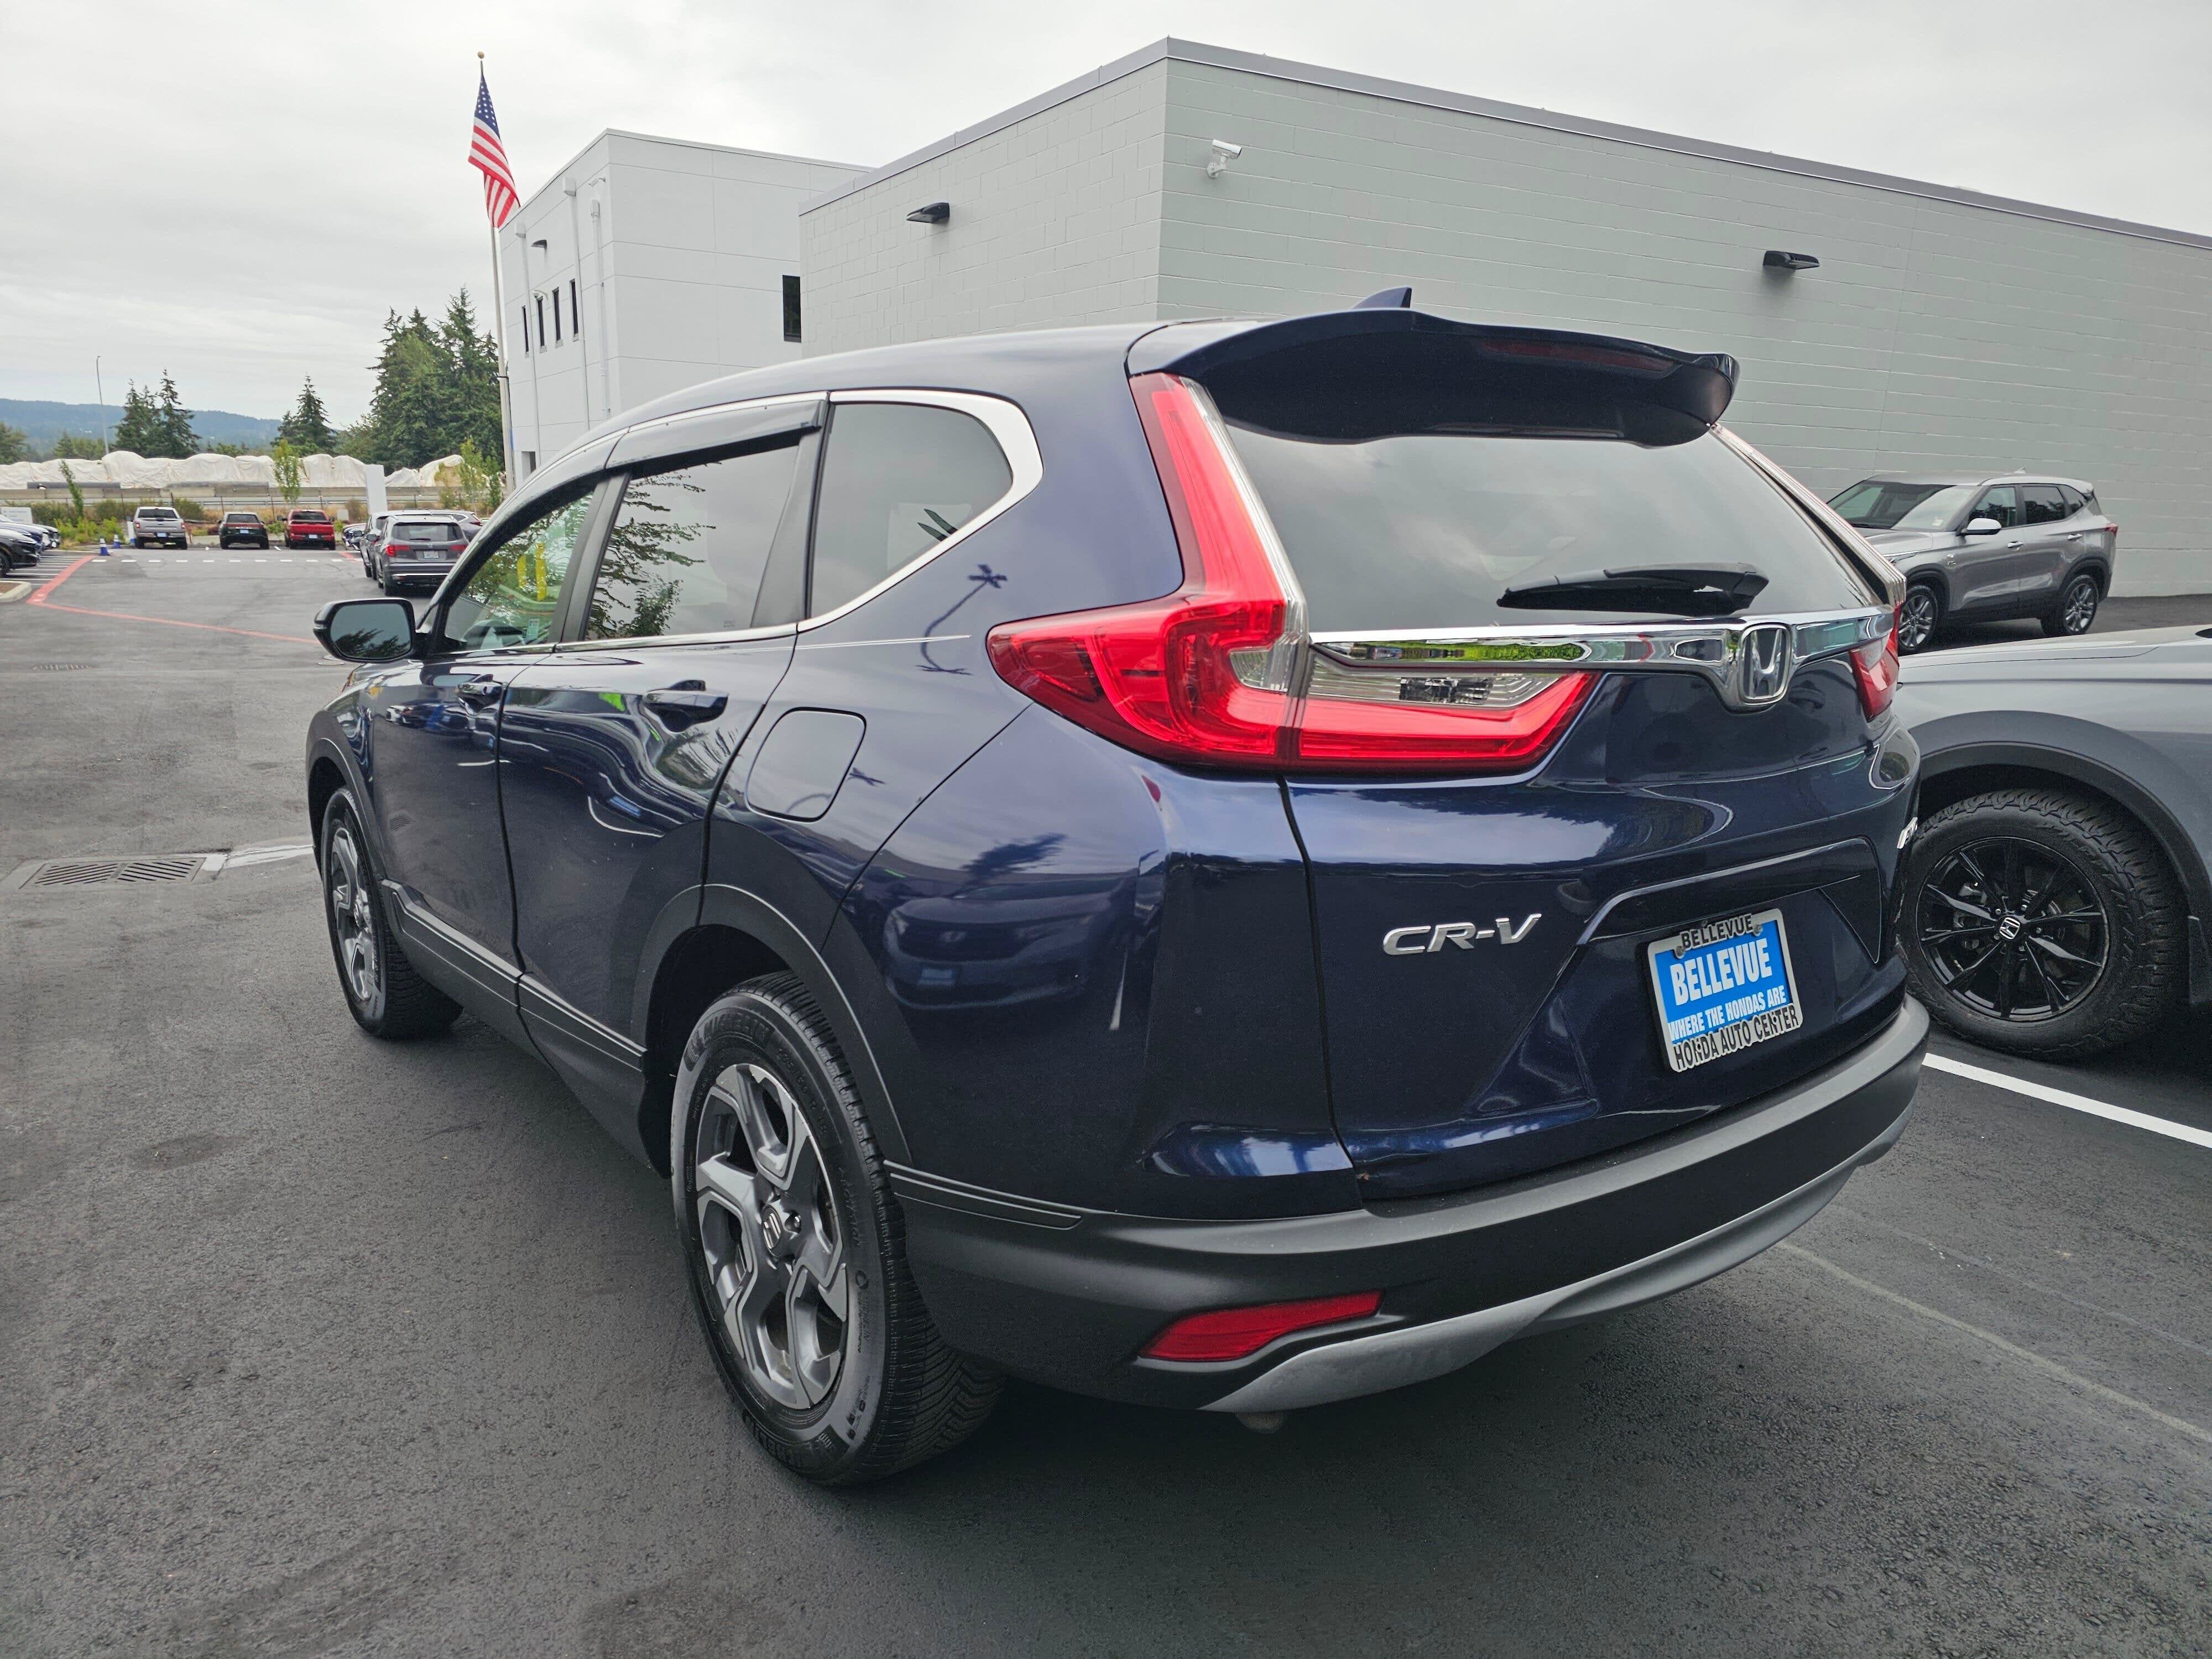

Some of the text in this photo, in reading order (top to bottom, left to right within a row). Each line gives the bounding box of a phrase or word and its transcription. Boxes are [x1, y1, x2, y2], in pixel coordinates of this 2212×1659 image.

[1383, 914, 1542, 955] CR-V
[1682, 915, 1754, 948] BELLEVUE
[1670, 938, 1772, 1005] BELLEVUE
[1668, 985, 1787, 1041] WHERE THE HONDAS ARE
[1673, 1005, 1799, 1071] HONDA AUTO CENTER
